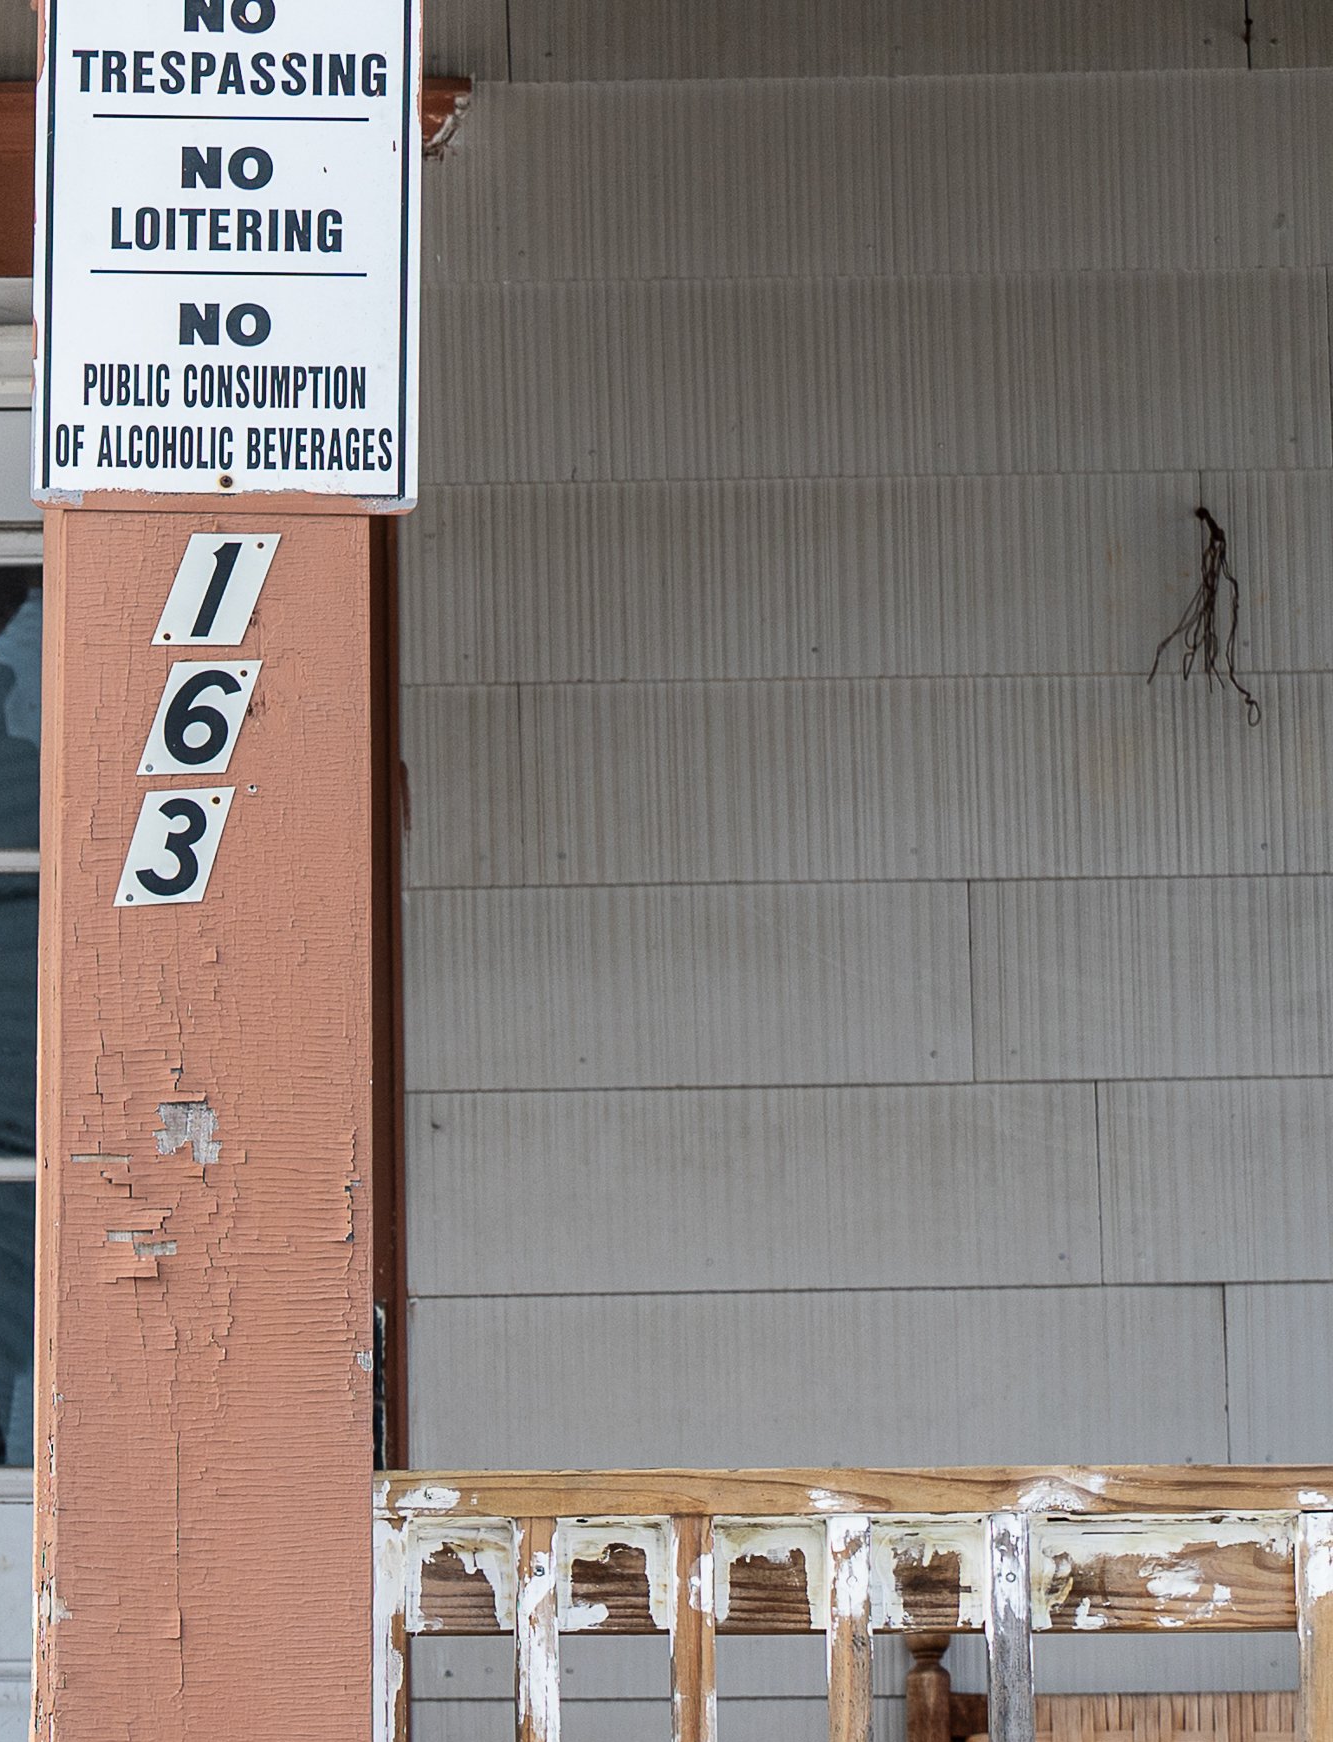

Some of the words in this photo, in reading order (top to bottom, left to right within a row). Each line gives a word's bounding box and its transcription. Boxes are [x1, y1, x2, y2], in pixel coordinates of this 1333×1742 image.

[184, 0, 276, 34] NO
[72, 49, 387, 97] TRESPASSING
[181, 146, 274, 190] NO
[110, 206, 344, 253] LOITERING
[178, 302, 272, 347] NO
[83, 363, 170, 408] PUBLIC
[183, 364, 367, 410] CONSUMPTION
[55, 423, 85, 468] OF
[97, 424, 233, 471] ALCOHOLIC
[247, 426, 393, 472] BEVERAGES
